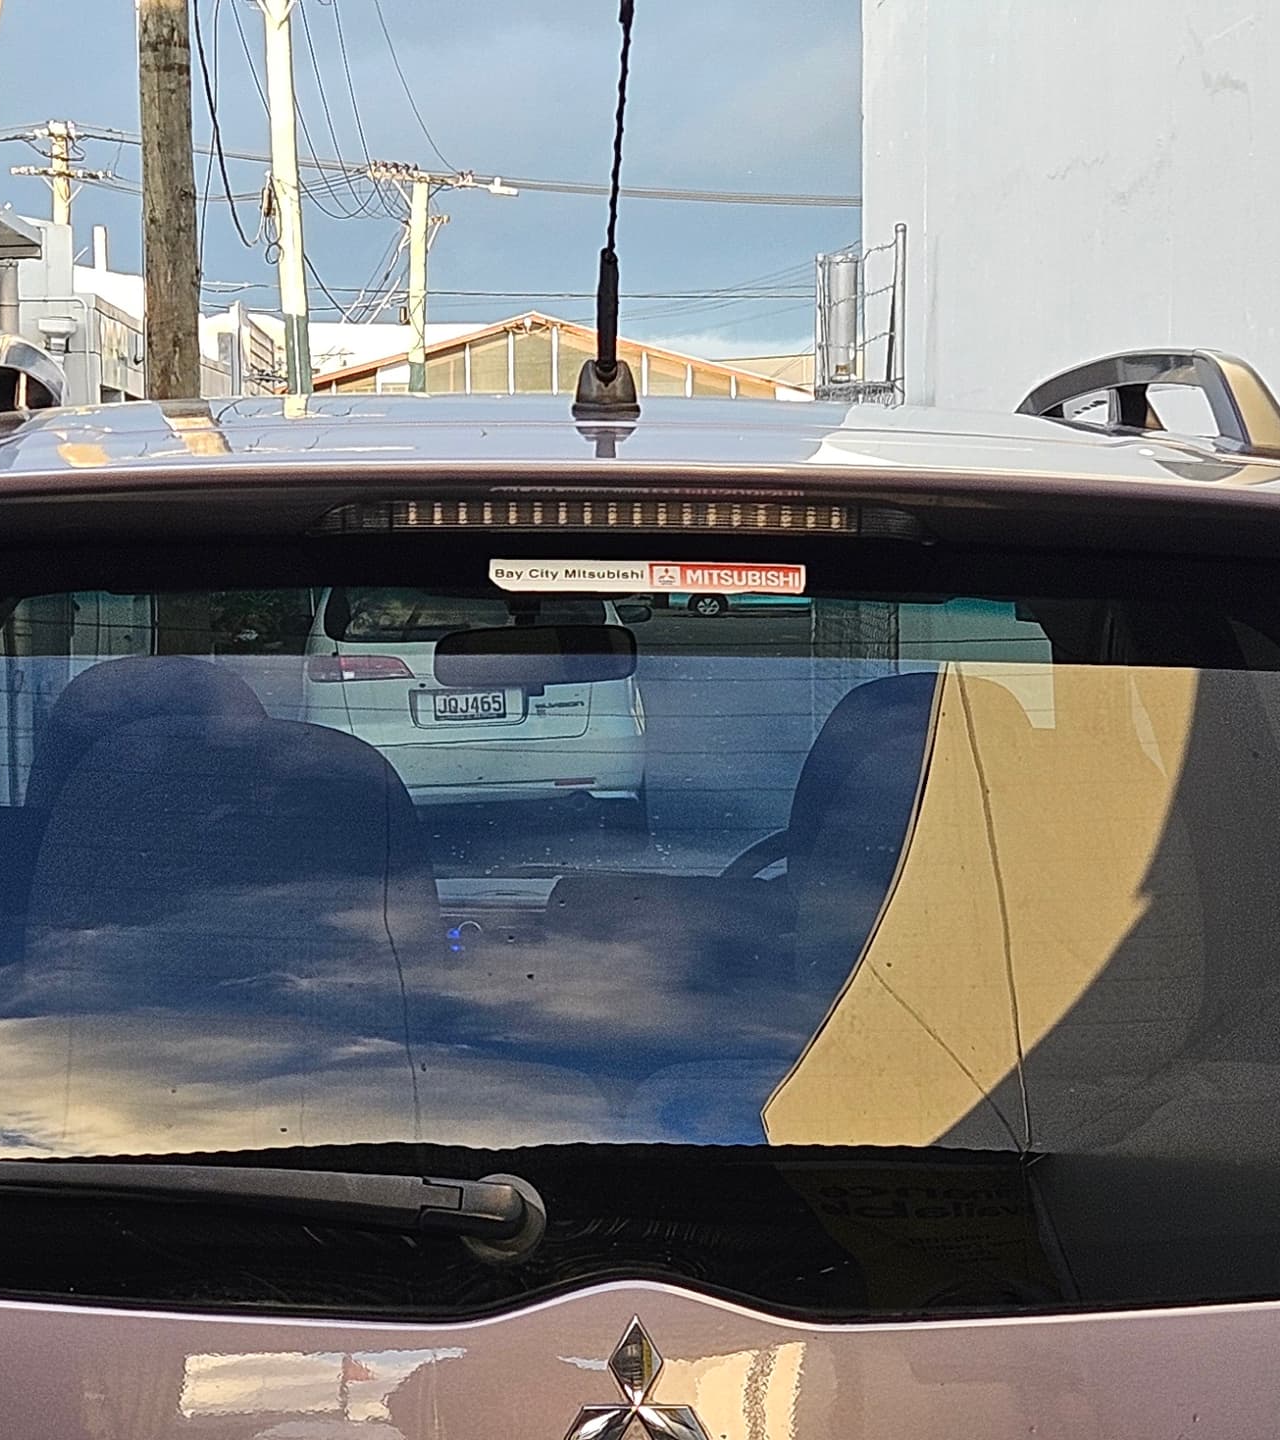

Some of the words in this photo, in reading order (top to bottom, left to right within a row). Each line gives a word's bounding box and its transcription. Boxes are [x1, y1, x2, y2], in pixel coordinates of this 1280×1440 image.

[494, 568, 524, 580] Bay
[528, 568, 559, 581] City
[564, 568, 644, 580] Mitsubishi
[685, 568, 800, 588] MITSUBISHI
[437, 695, 502, 714] JQJ465
